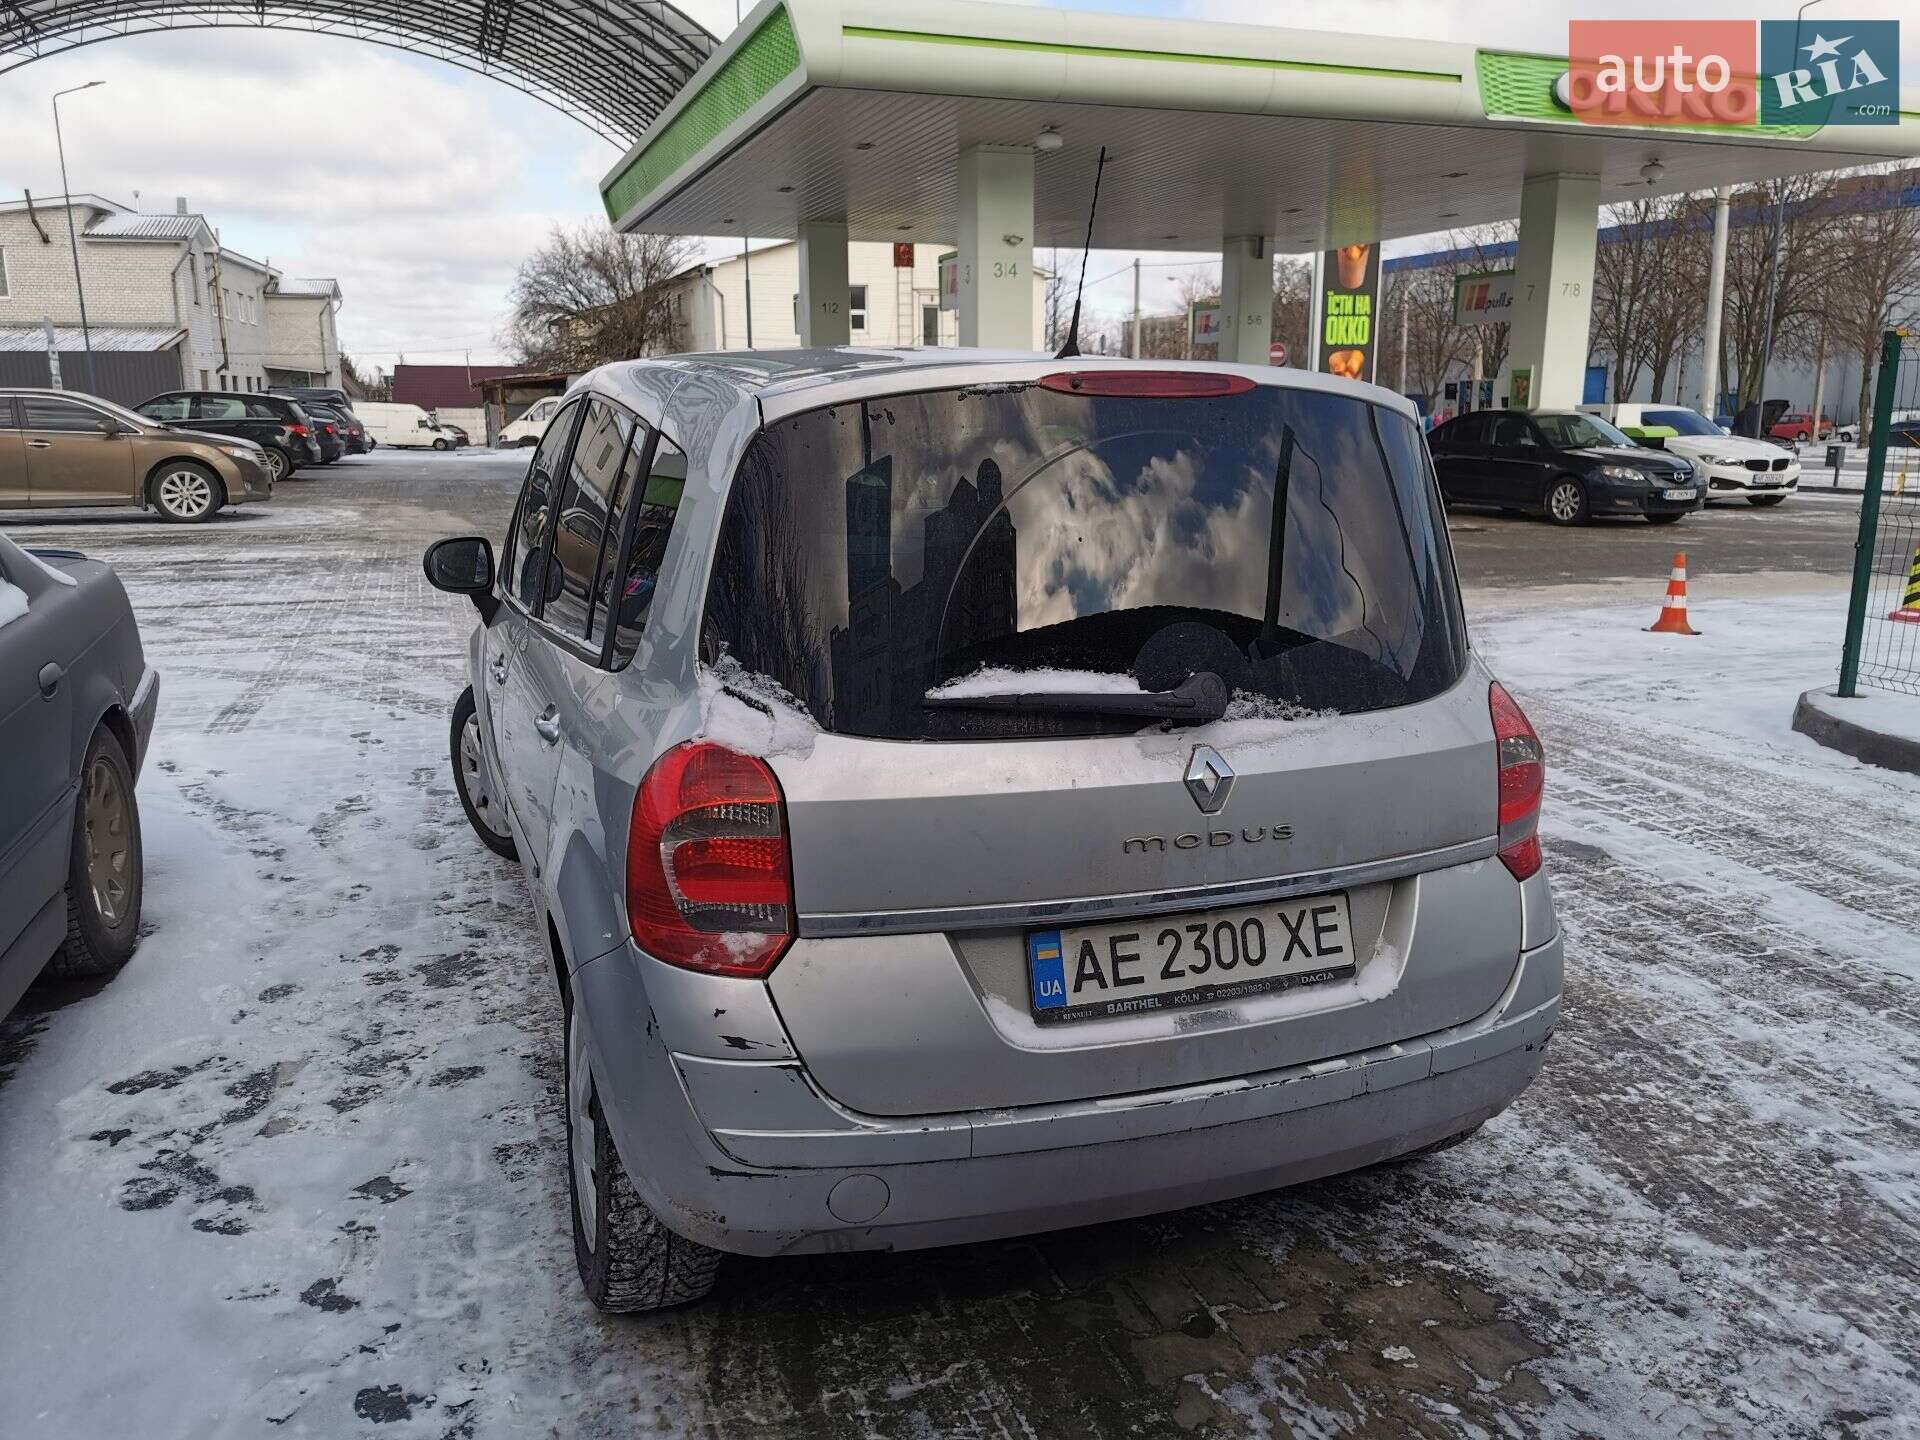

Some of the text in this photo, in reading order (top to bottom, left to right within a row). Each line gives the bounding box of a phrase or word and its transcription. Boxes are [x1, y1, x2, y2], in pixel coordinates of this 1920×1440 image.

[1072, 905, 1344, 993] AE 2300 XE
[1040, 978, 1063, 998] UA
[1107, 998, 1163, 1014] BARTHEL
[1174, 993, 1200, 1005] KÖLN
[1301, 972, 1335, 984] DACIA
